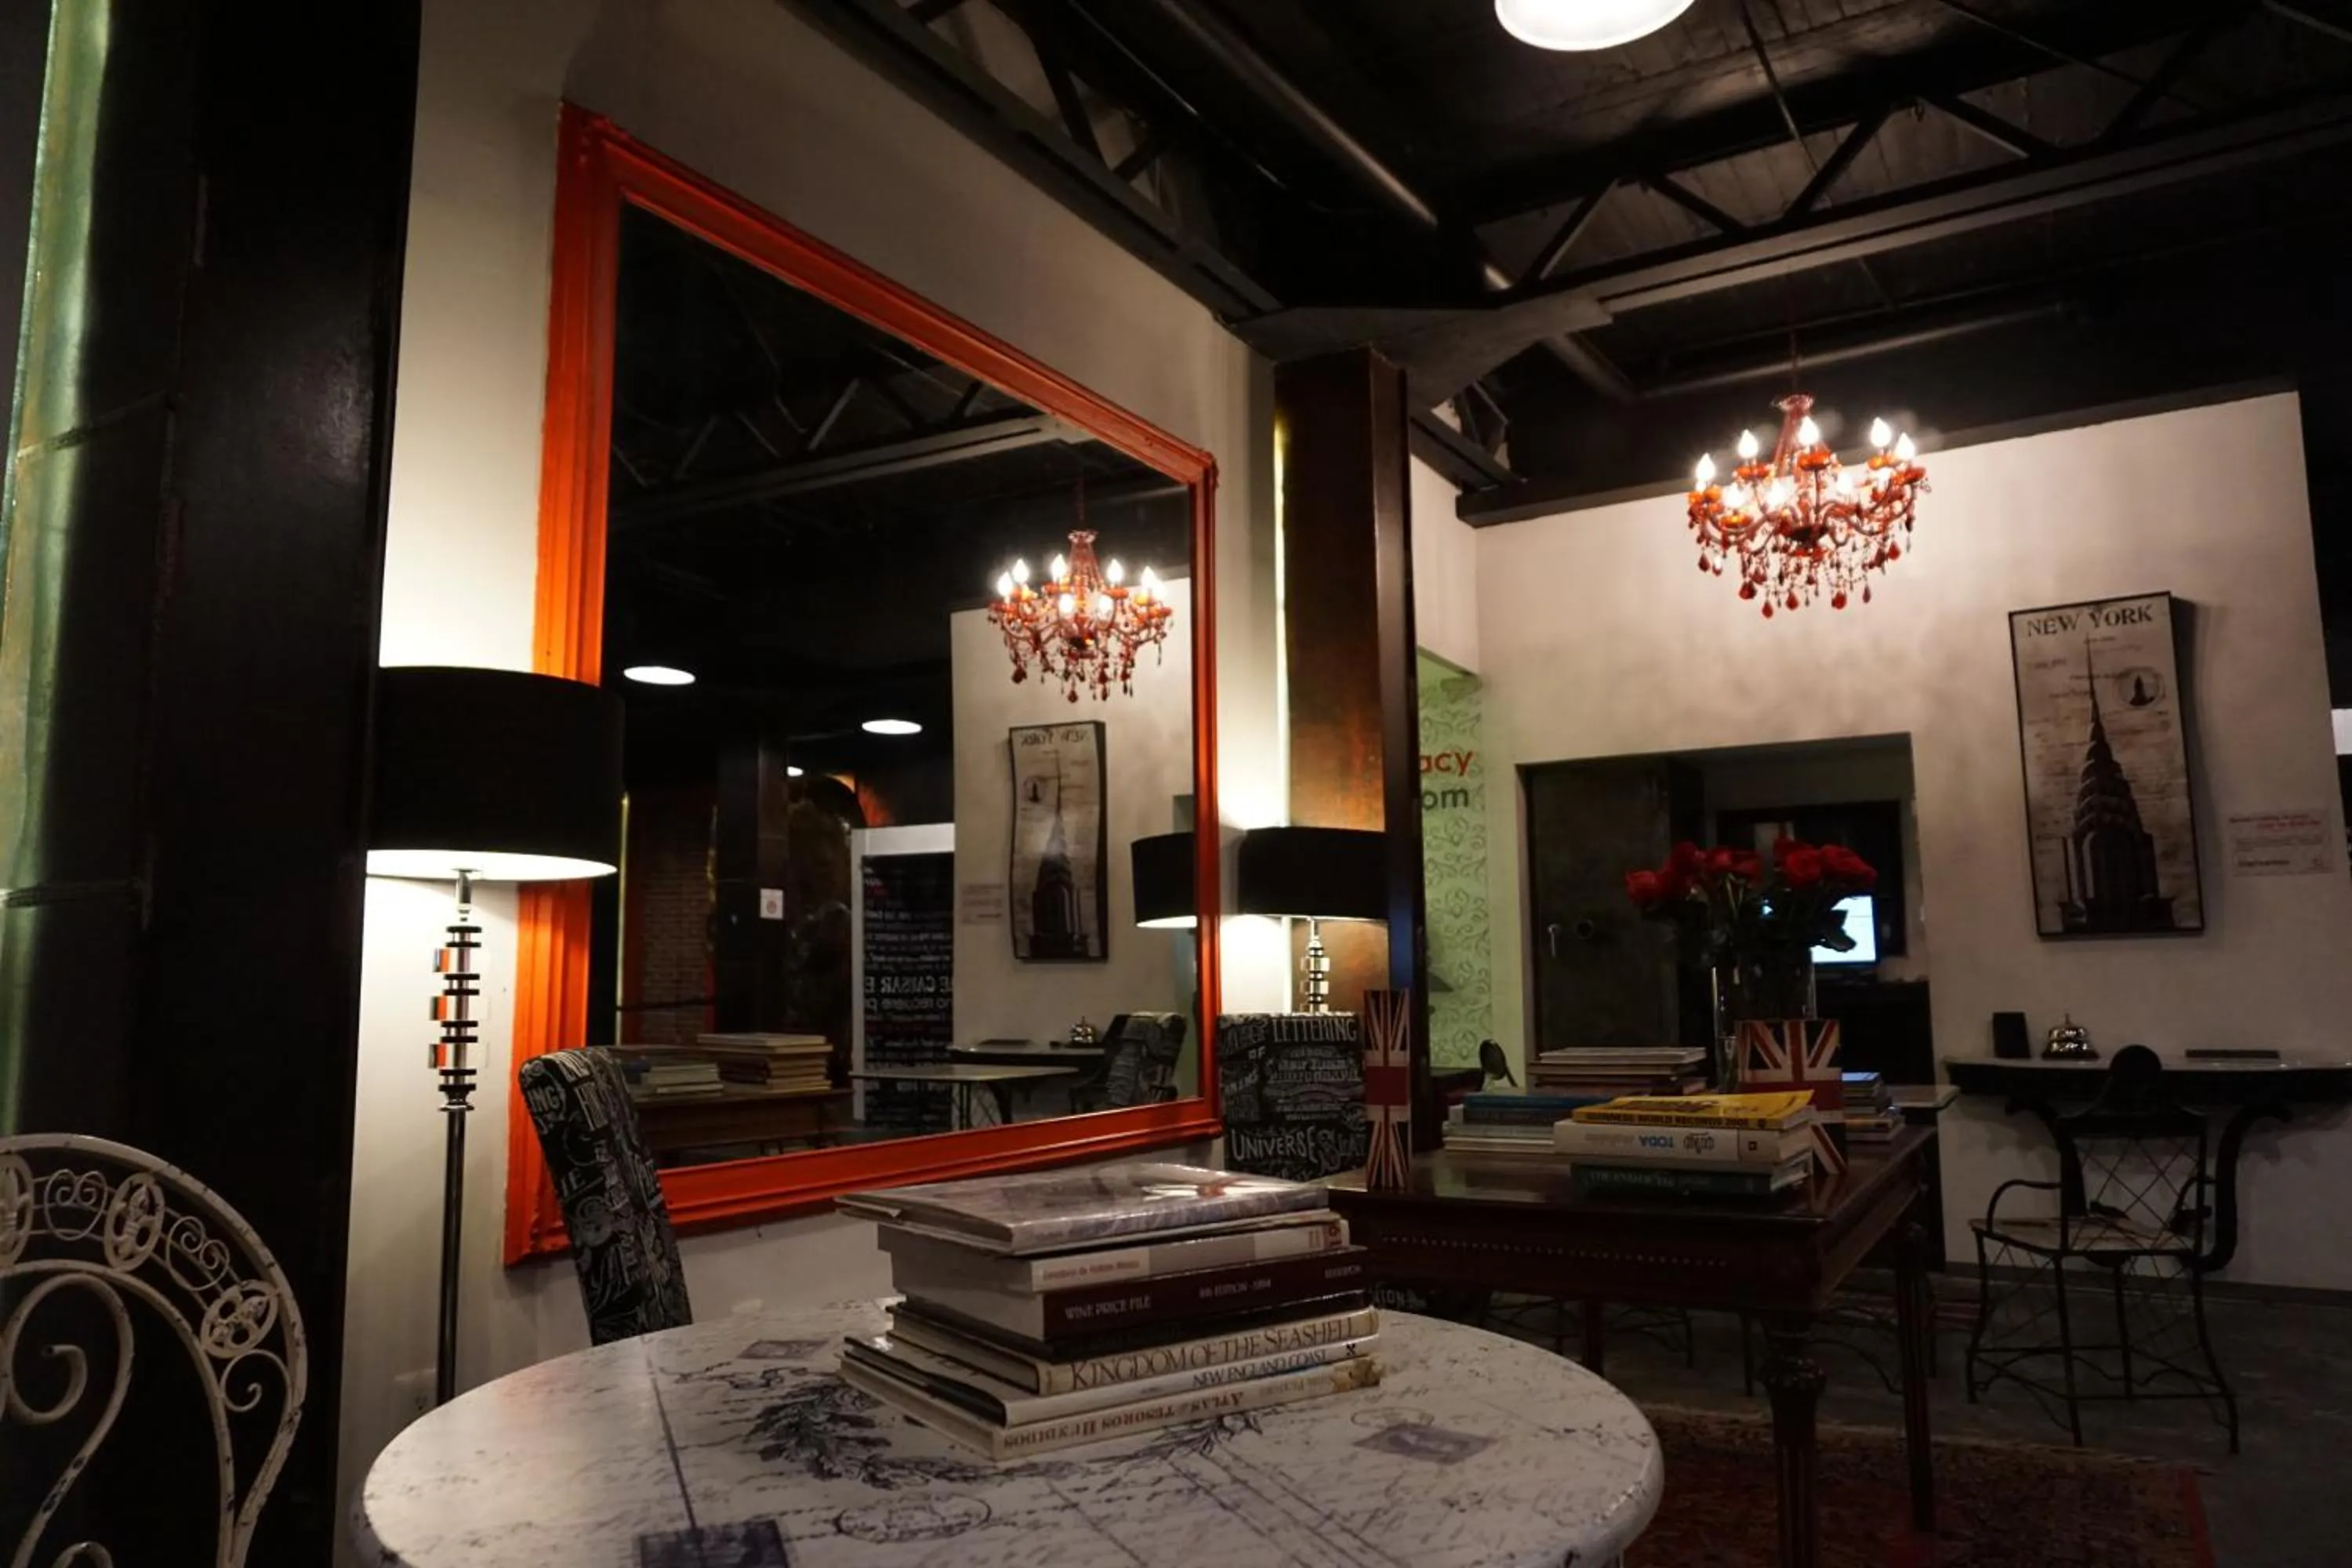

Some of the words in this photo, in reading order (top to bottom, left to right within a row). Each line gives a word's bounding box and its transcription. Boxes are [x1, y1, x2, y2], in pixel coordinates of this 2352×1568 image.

[2027, 613, 2079, 637] NEW
[2089, 604, 2153, 628] YORK
[1272, 1018, 1357, 1043] LETTERING
[1637, 1114, 1672, 1124] WORLD
[1675, 1116, 1723, 1127] RECORDS
[1231, 1127, 1319, 1163] UNIVERSE
[1639, 1135, 1675, 1149] TODA
[1064, 1303, 1094, 1320] WINE
[1095, 1300, 1127, 1318] PRICE
[1129, 1294, 1151, 1312] FILE
[1071, 1347, 1187, 1391] KINGDOM
[1190, 1344, 1218, 1367] OF
[1220, 1336, 1261, 1361] THE
[1263, 1319, 1353, 1352] SEASHELL
[1192, 1369, 1224, 1388] NEW
[1227, 1356, 1286, 1381] ENGLAND
[1287, 1348, 1327, 1368] COAST
[1191, 1391, 1244, 1414] ATLAS
[1101, 1406, 1175, 1430] TESOROS
[1004, 1420, 1097, 1450] HUNDIDOS
